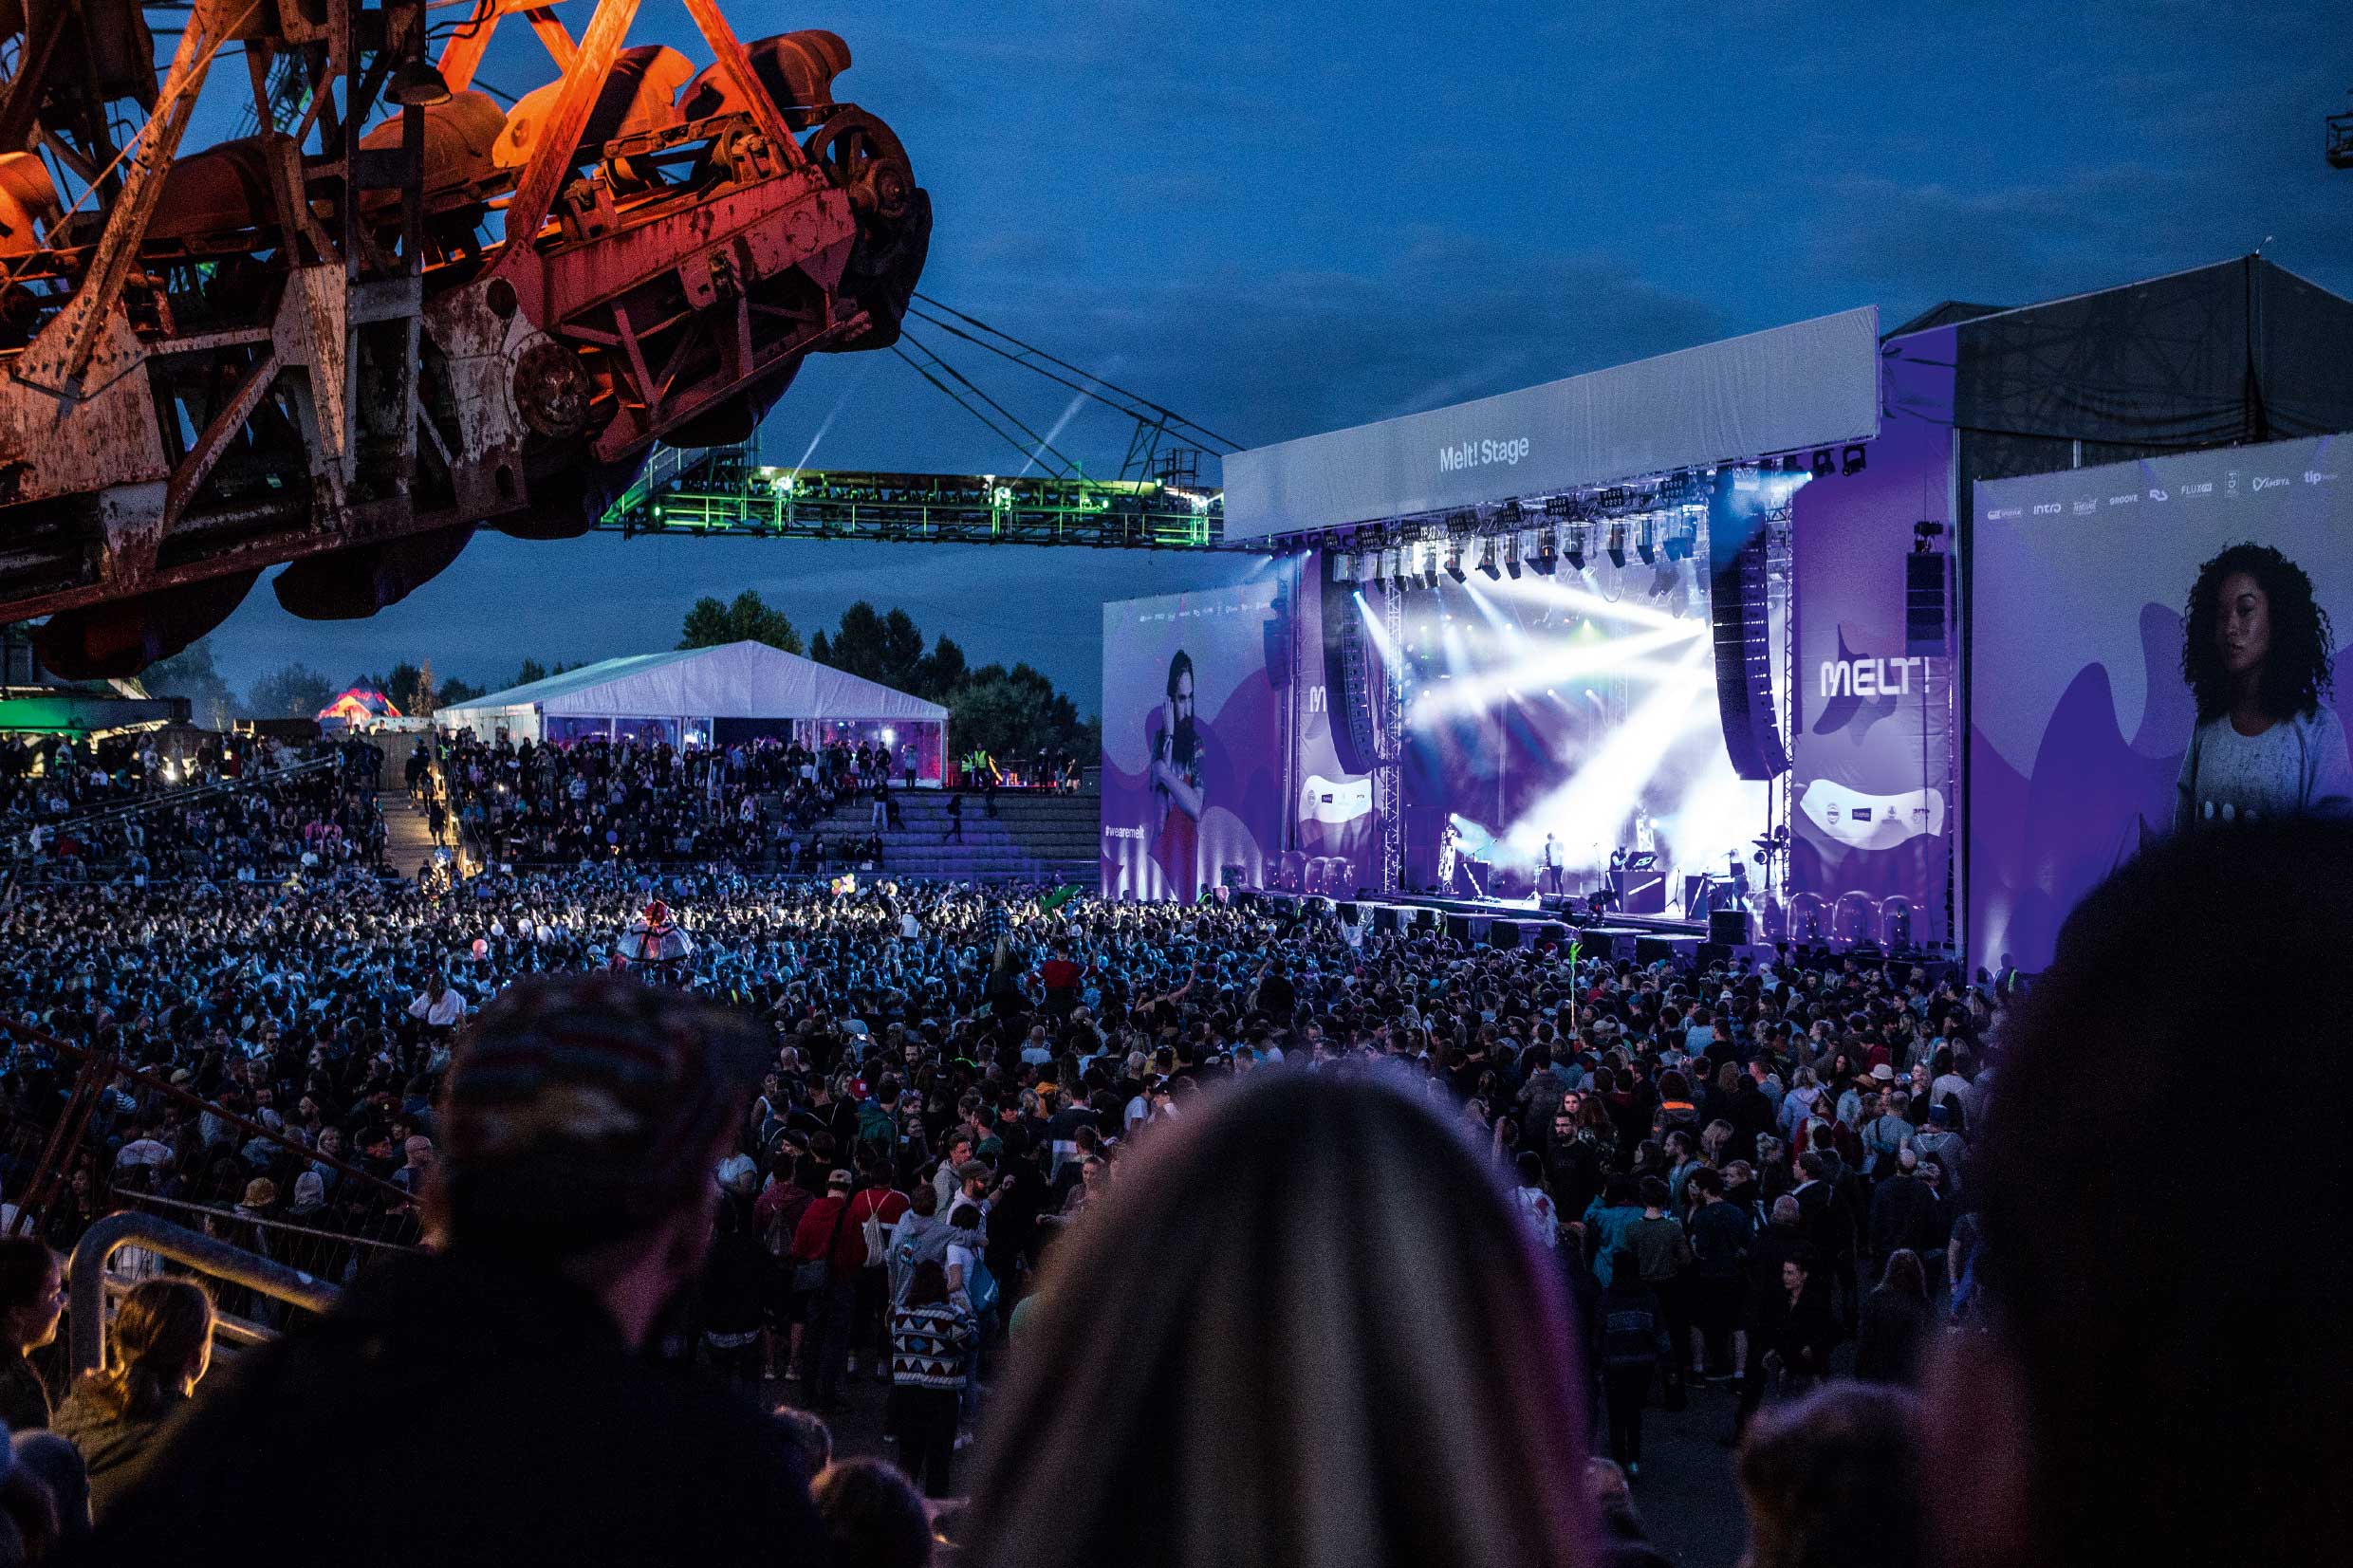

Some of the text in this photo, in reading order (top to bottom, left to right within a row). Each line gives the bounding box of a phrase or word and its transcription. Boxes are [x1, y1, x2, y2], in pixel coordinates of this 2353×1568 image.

[1440, 437, 1529, 472] Melt! Stage
[2304, 470, 2322, 485] tip
[2109, 494, 2139, 506] GROOVE
[1821, 656, 1930, 697] MELT!
[1105, 824, 1144, 839] #wearemelt
